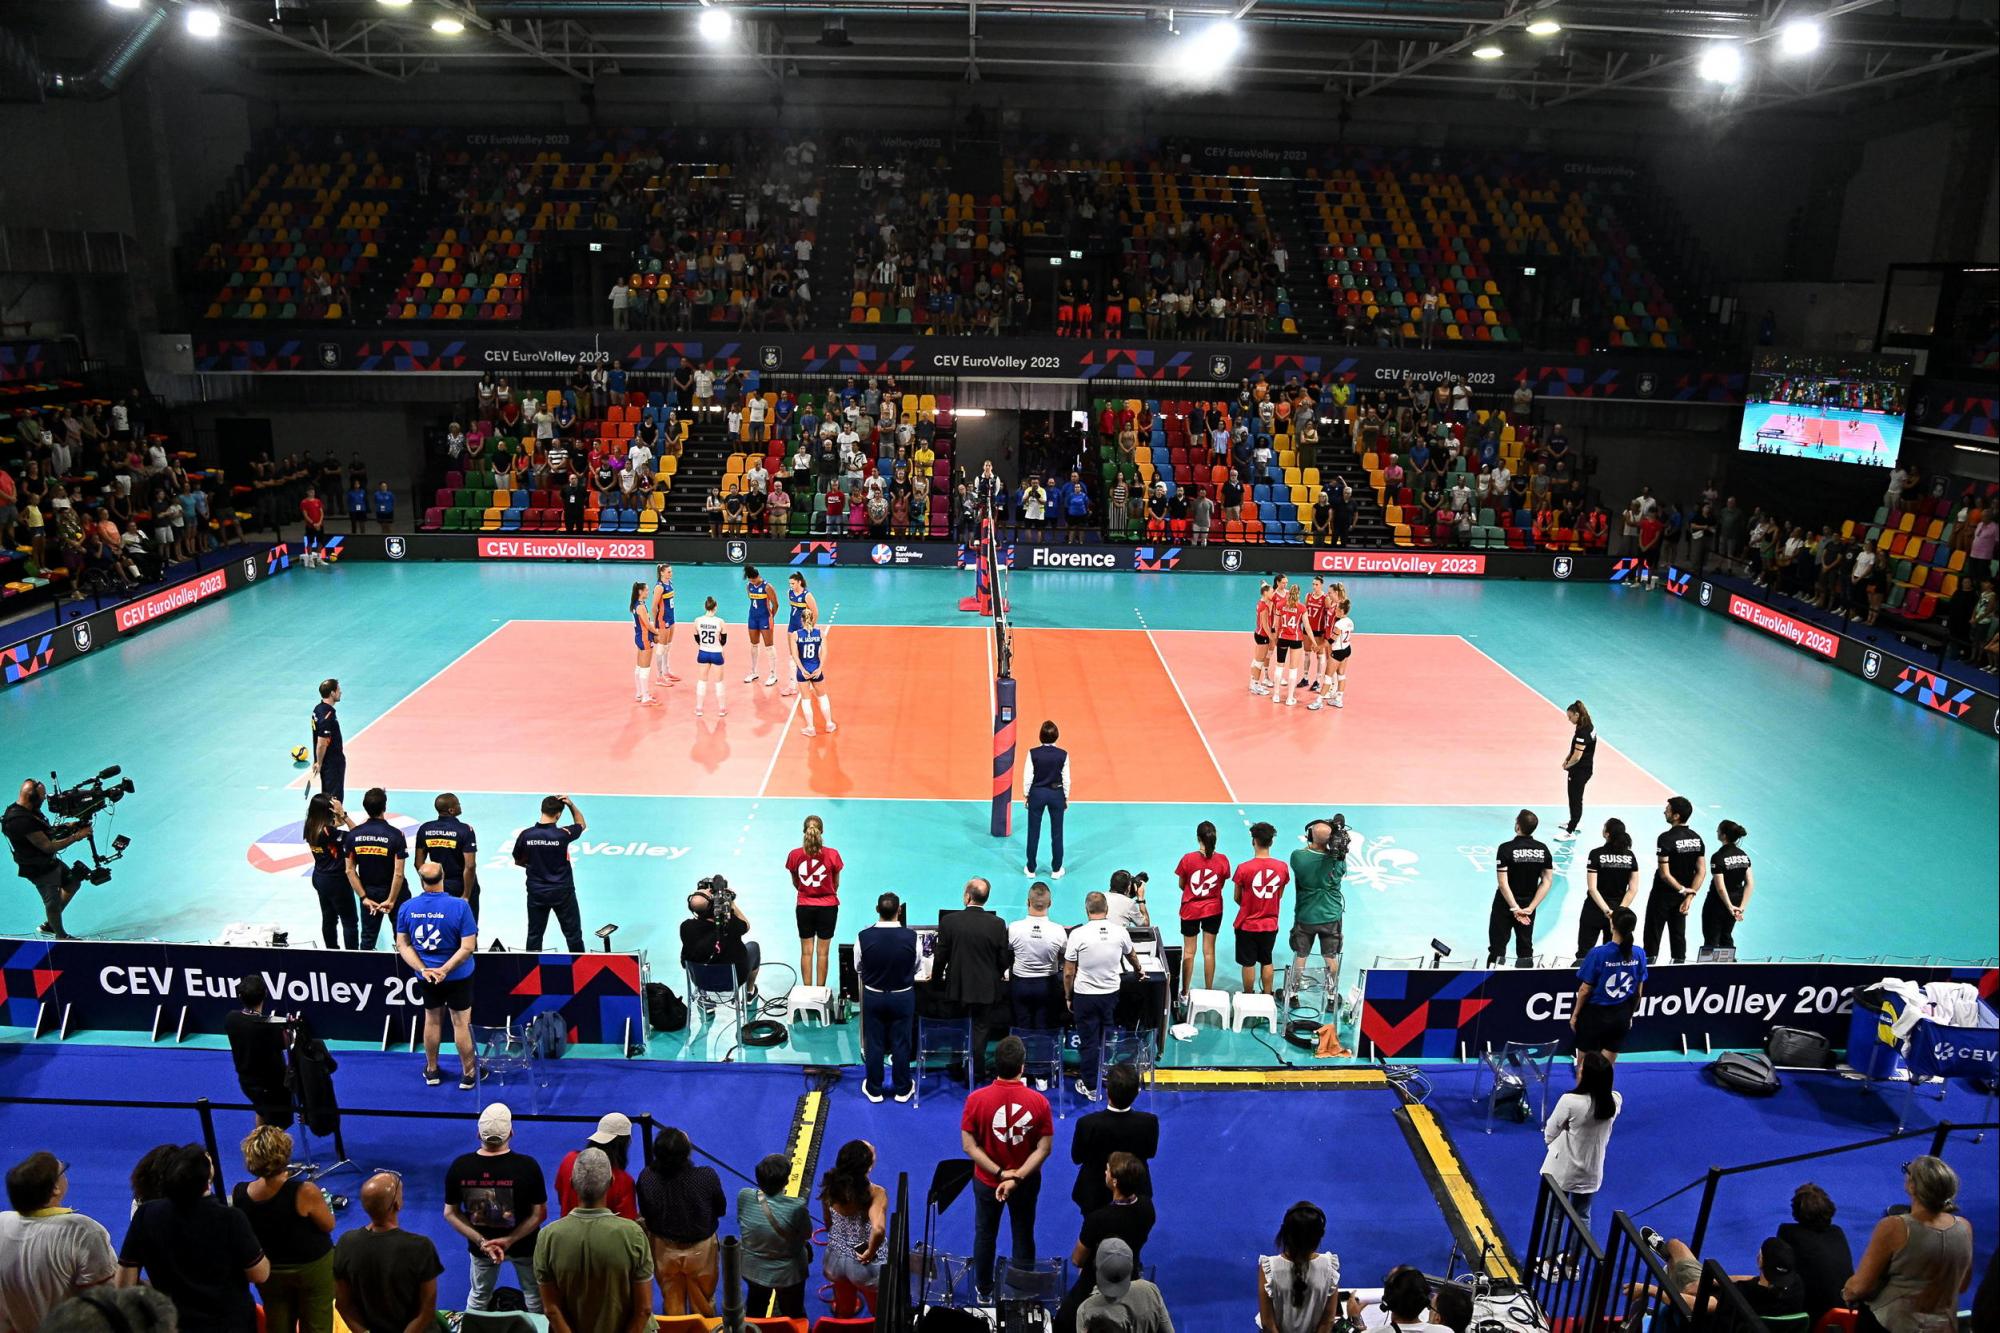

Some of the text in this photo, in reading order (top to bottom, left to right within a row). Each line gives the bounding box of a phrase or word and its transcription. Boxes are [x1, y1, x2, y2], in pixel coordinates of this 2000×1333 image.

[466, 134, 485, 145] CEV
[545, 134, 570, 145] 2023
[1204, 146, 1225, 158] CEV
[1282, 149, 1308, 161] 2023
[484, 350, 609, 365] CEV EuroVolley 2023
[933, 355, 1060, 371] CEV EuroVolley 2023
[1375, 368, 1399, 380] CEV
[1467, 372, 1495, 384] 2023
[487, 541, 646, 561] CEV EuroVolley 2023
[1032, 547, 1117, 568] Florence
[1322, 555, 1477, 575] CEV EuroVolley 2023
[122, 575, 222, 627] CEV EuroVolley 2023
[792, 607, 798, 616] 7
[1307, 606, 1319, 618] 17
[1281, 614, 1297, 629] 14
[1733, 600, 1833, 654] CEV EuroVolley 2023
[701, 630, 716, 645] 25
[802, 643, 816, 659] 18
[355, 835, 388, 844] NEDERLAND
[425, 829, 457, 838] NEDERLAND
[526, 839, 560, 847] NEDERLAND
[1513, 848, 1545, 860] SUISSE
[1599, 854, 1632, 865] SUISSE
[411, 911, 445, 919] Team Guide
[1604, 960, 1621, 968] Team
[99, 965, 425, 1011] CEV EurVolley 20
[1525, 985, 1854, 1022] CE uroVolley 202
[1958, 1047, 1998, 1063] CEV
